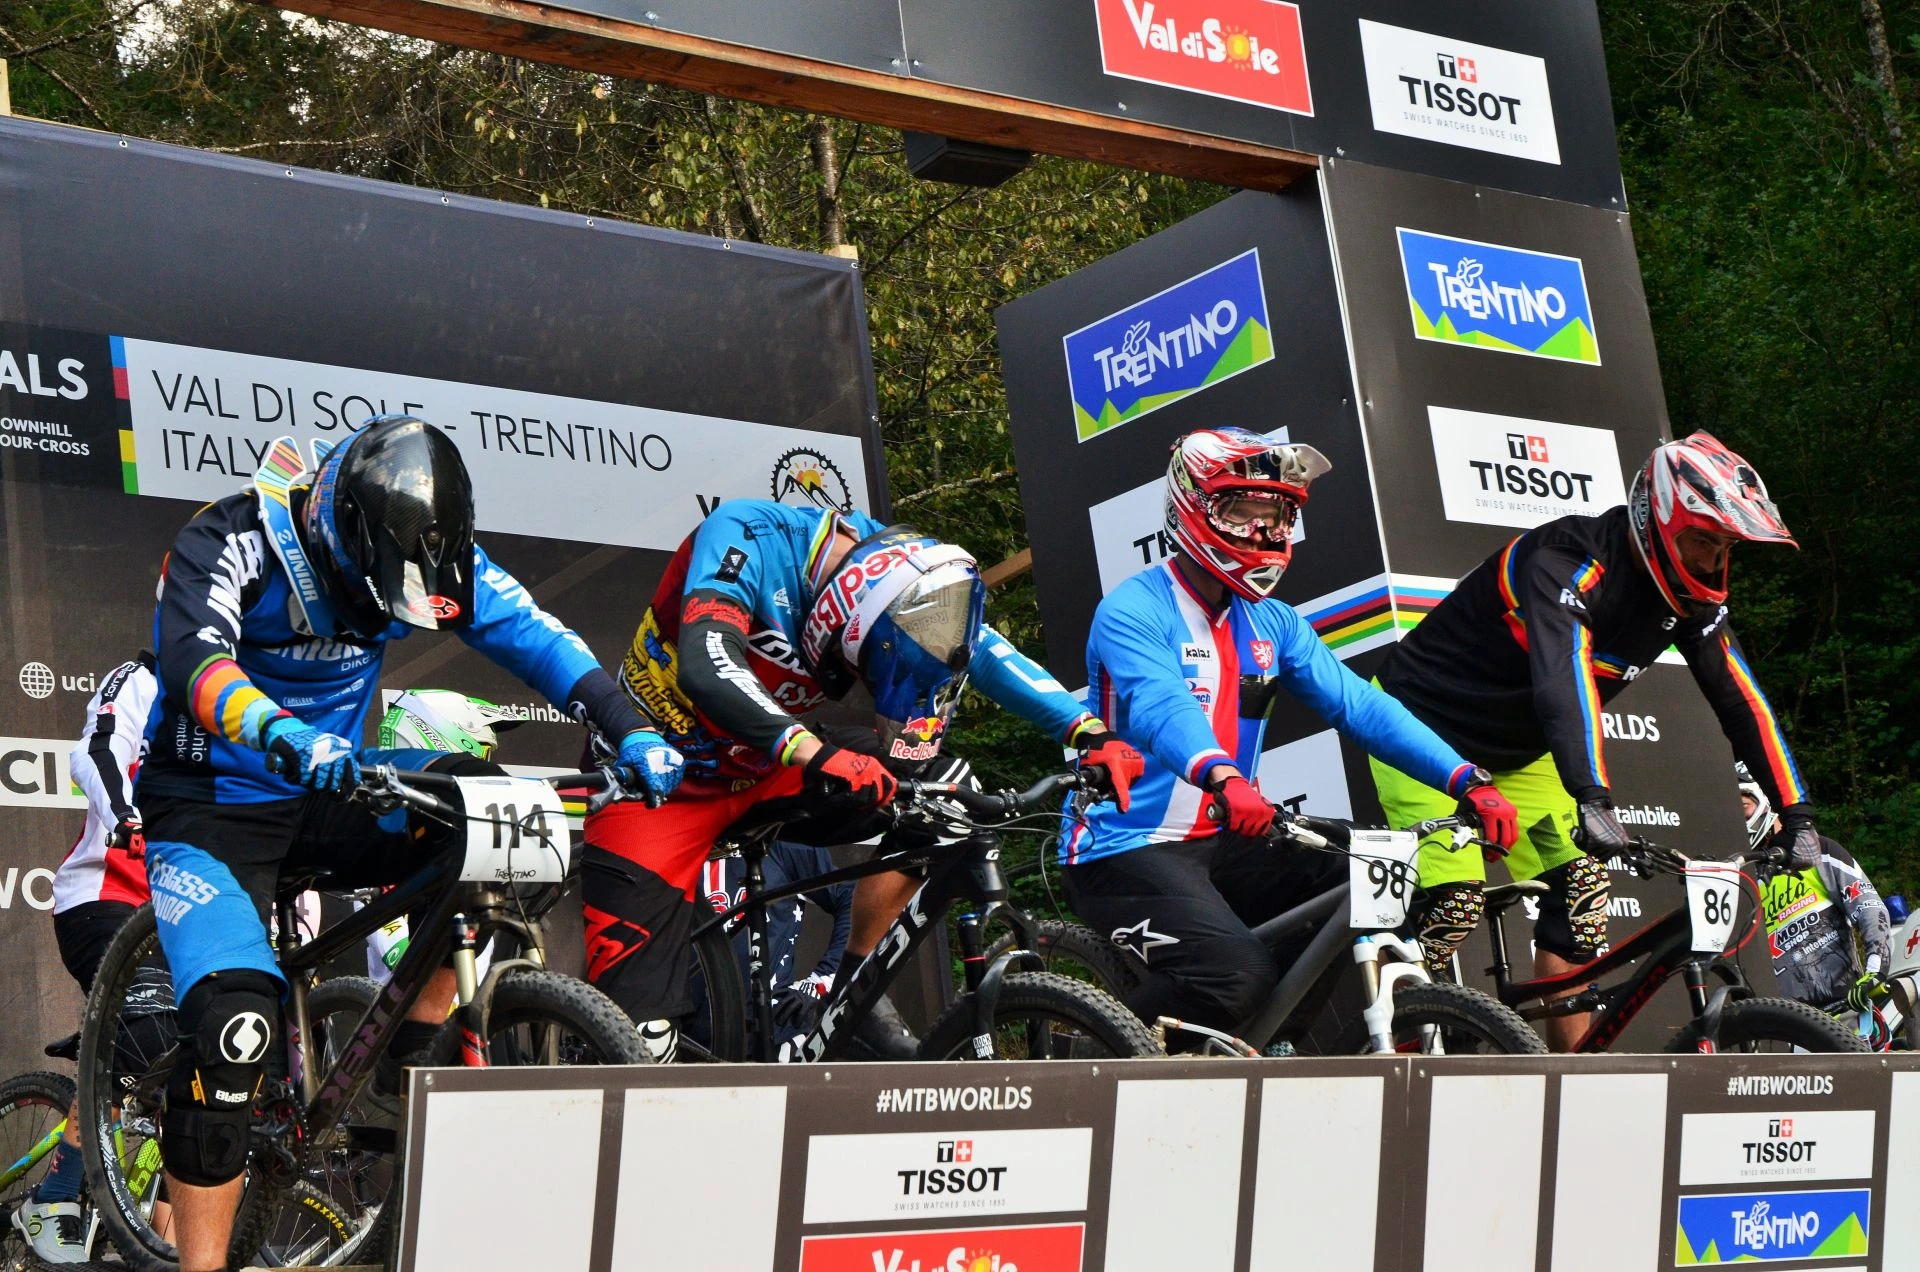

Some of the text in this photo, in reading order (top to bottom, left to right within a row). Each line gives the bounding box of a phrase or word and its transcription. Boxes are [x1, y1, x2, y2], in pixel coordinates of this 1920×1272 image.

[1122, 0, 1178, 53] Val
[1181, 32, 1204, 58] di
[1398, 75, 1521, 125] TISSOT
[1436, 118, 1477, 134] WATCHES
[1427, 262, 1567, 327] TRENTINO
[1094, 299, 1239, 393] TRENTINO
[152, 369, 240, 419] VAL
[252, 382, 296, 426] DI
[470, 411, 672, 472] TRENTINO
[162, 428, 270, 478] ITALY
[1469, 460, 1593, 502] TISSOT
[286, 547, 320, 603] UNIOR
[1185, 647, 1211, 659] kalas
[485, 803, 553, 849] 114
[1368, 860, 1405, 900] 98
[1704, 889, 1731, 925] 86
[1779, 895, 1817, 921] RACING
[1776, 911, 1819, 946] MOTO
[1784, 931, 1810, 951] SHOP
[876, 1086, 1032, 1112] #MTBWORLDS
[1727, 1075, 1834, 1096] #MTBWORLDS
[1742, 1141, 1816, 1164] TISSOT
[898, 1167, 1007, 1195] TISSOT
[923, 1200, 959, 1210] WATCHES
[1731, 1210, 1820, 1250] TRENTINO
